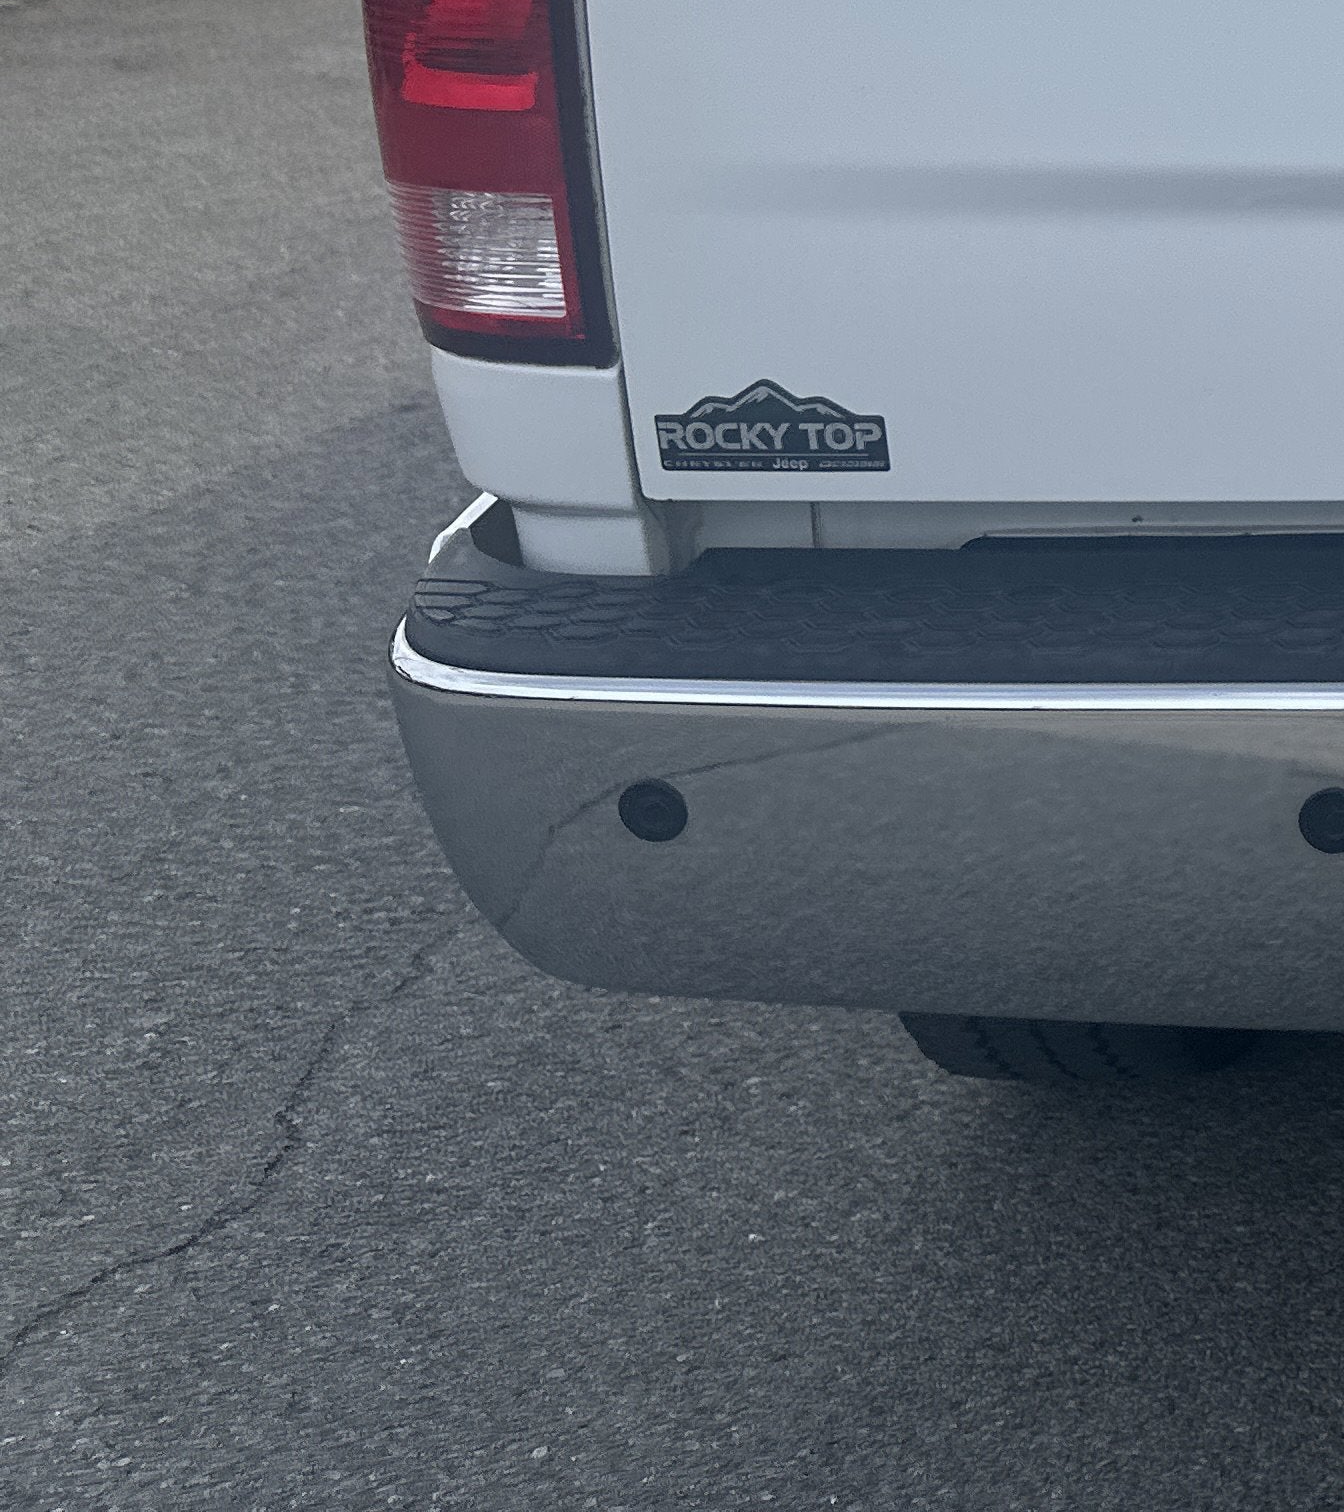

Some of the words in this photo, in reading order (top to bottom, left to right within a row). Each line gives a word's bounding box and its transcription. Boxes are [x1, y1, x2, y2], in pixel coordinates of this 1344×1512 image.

[656, 422, 791, 450] ROCKY
[799, 422, 882, 450] TOP
[772, 457, 809, 471] Jeep
